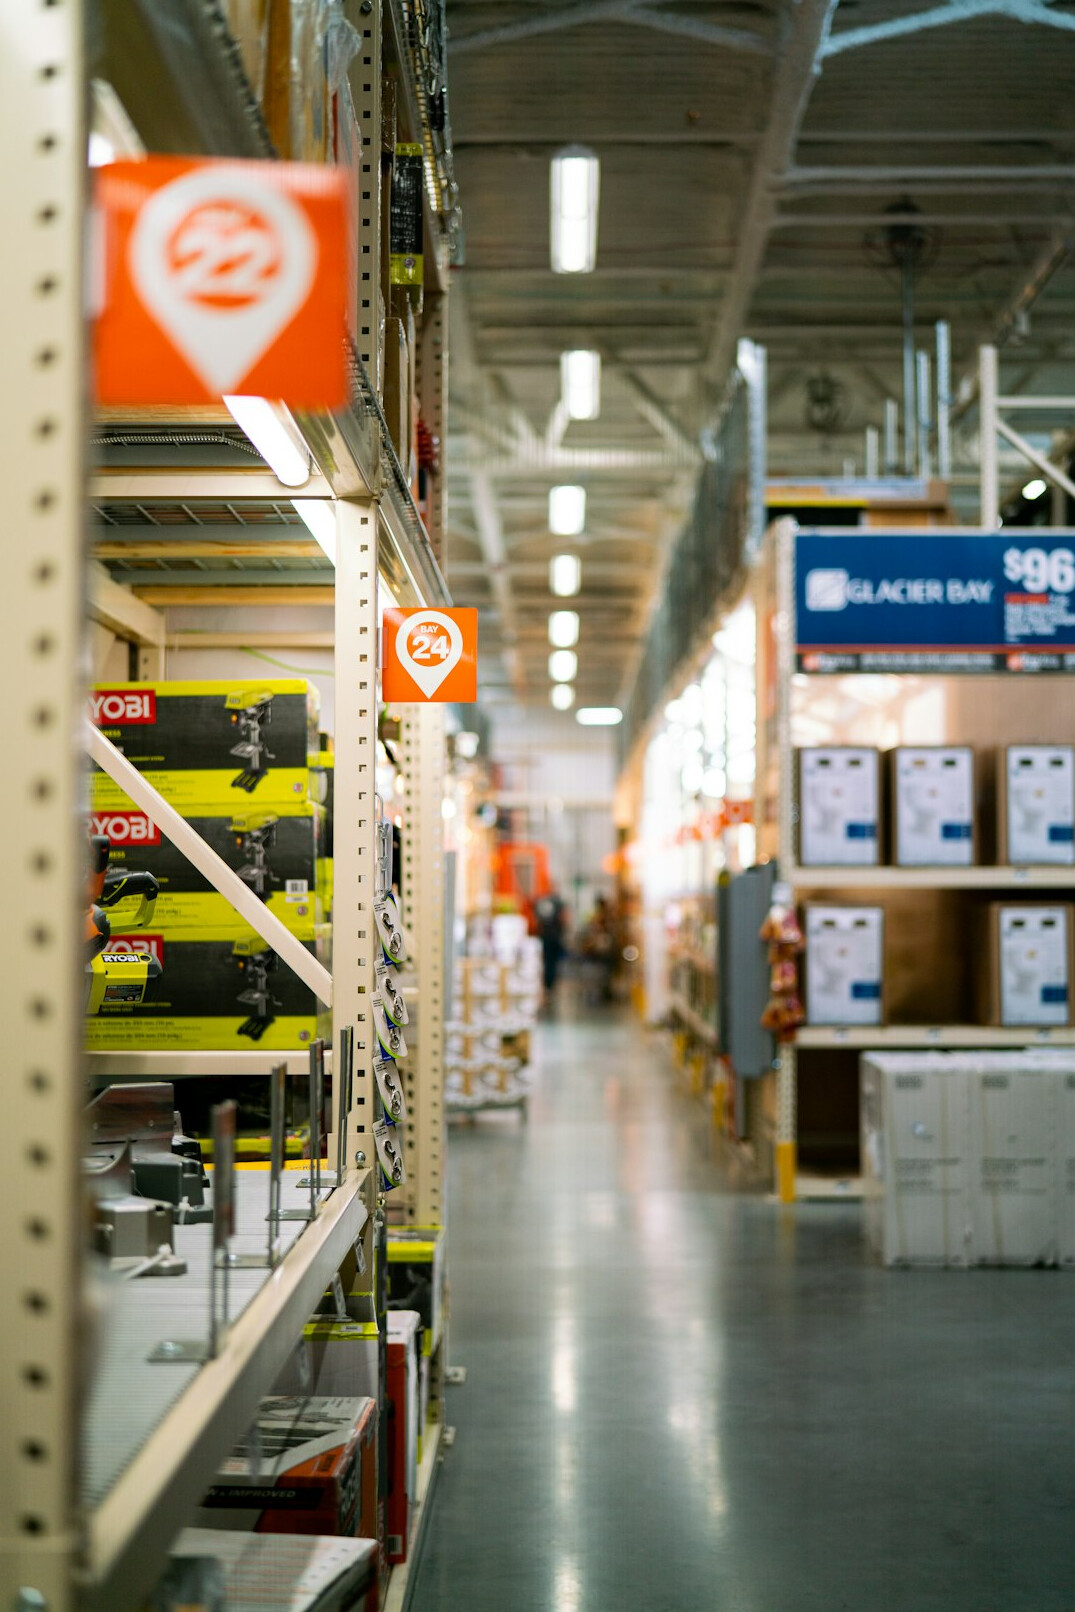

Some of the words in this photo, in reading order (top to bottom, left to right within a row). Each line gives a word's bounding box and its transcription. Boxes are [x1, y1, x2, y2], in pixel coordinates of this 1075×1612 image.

[171, 225, 276, 292] 22
[1003, 547, 1075, 593] $96
[847, 578, 944, 604] GLACIER
[947, 578, 994, 604] BAY
[420, 625, 439, 633] BAY
[411, 635, 450, 659] 24
[88, 695, 150, 719] YOBI
[88, 815, 155, 840] YOBI
[102, 954, 139, 962] RYOBI
